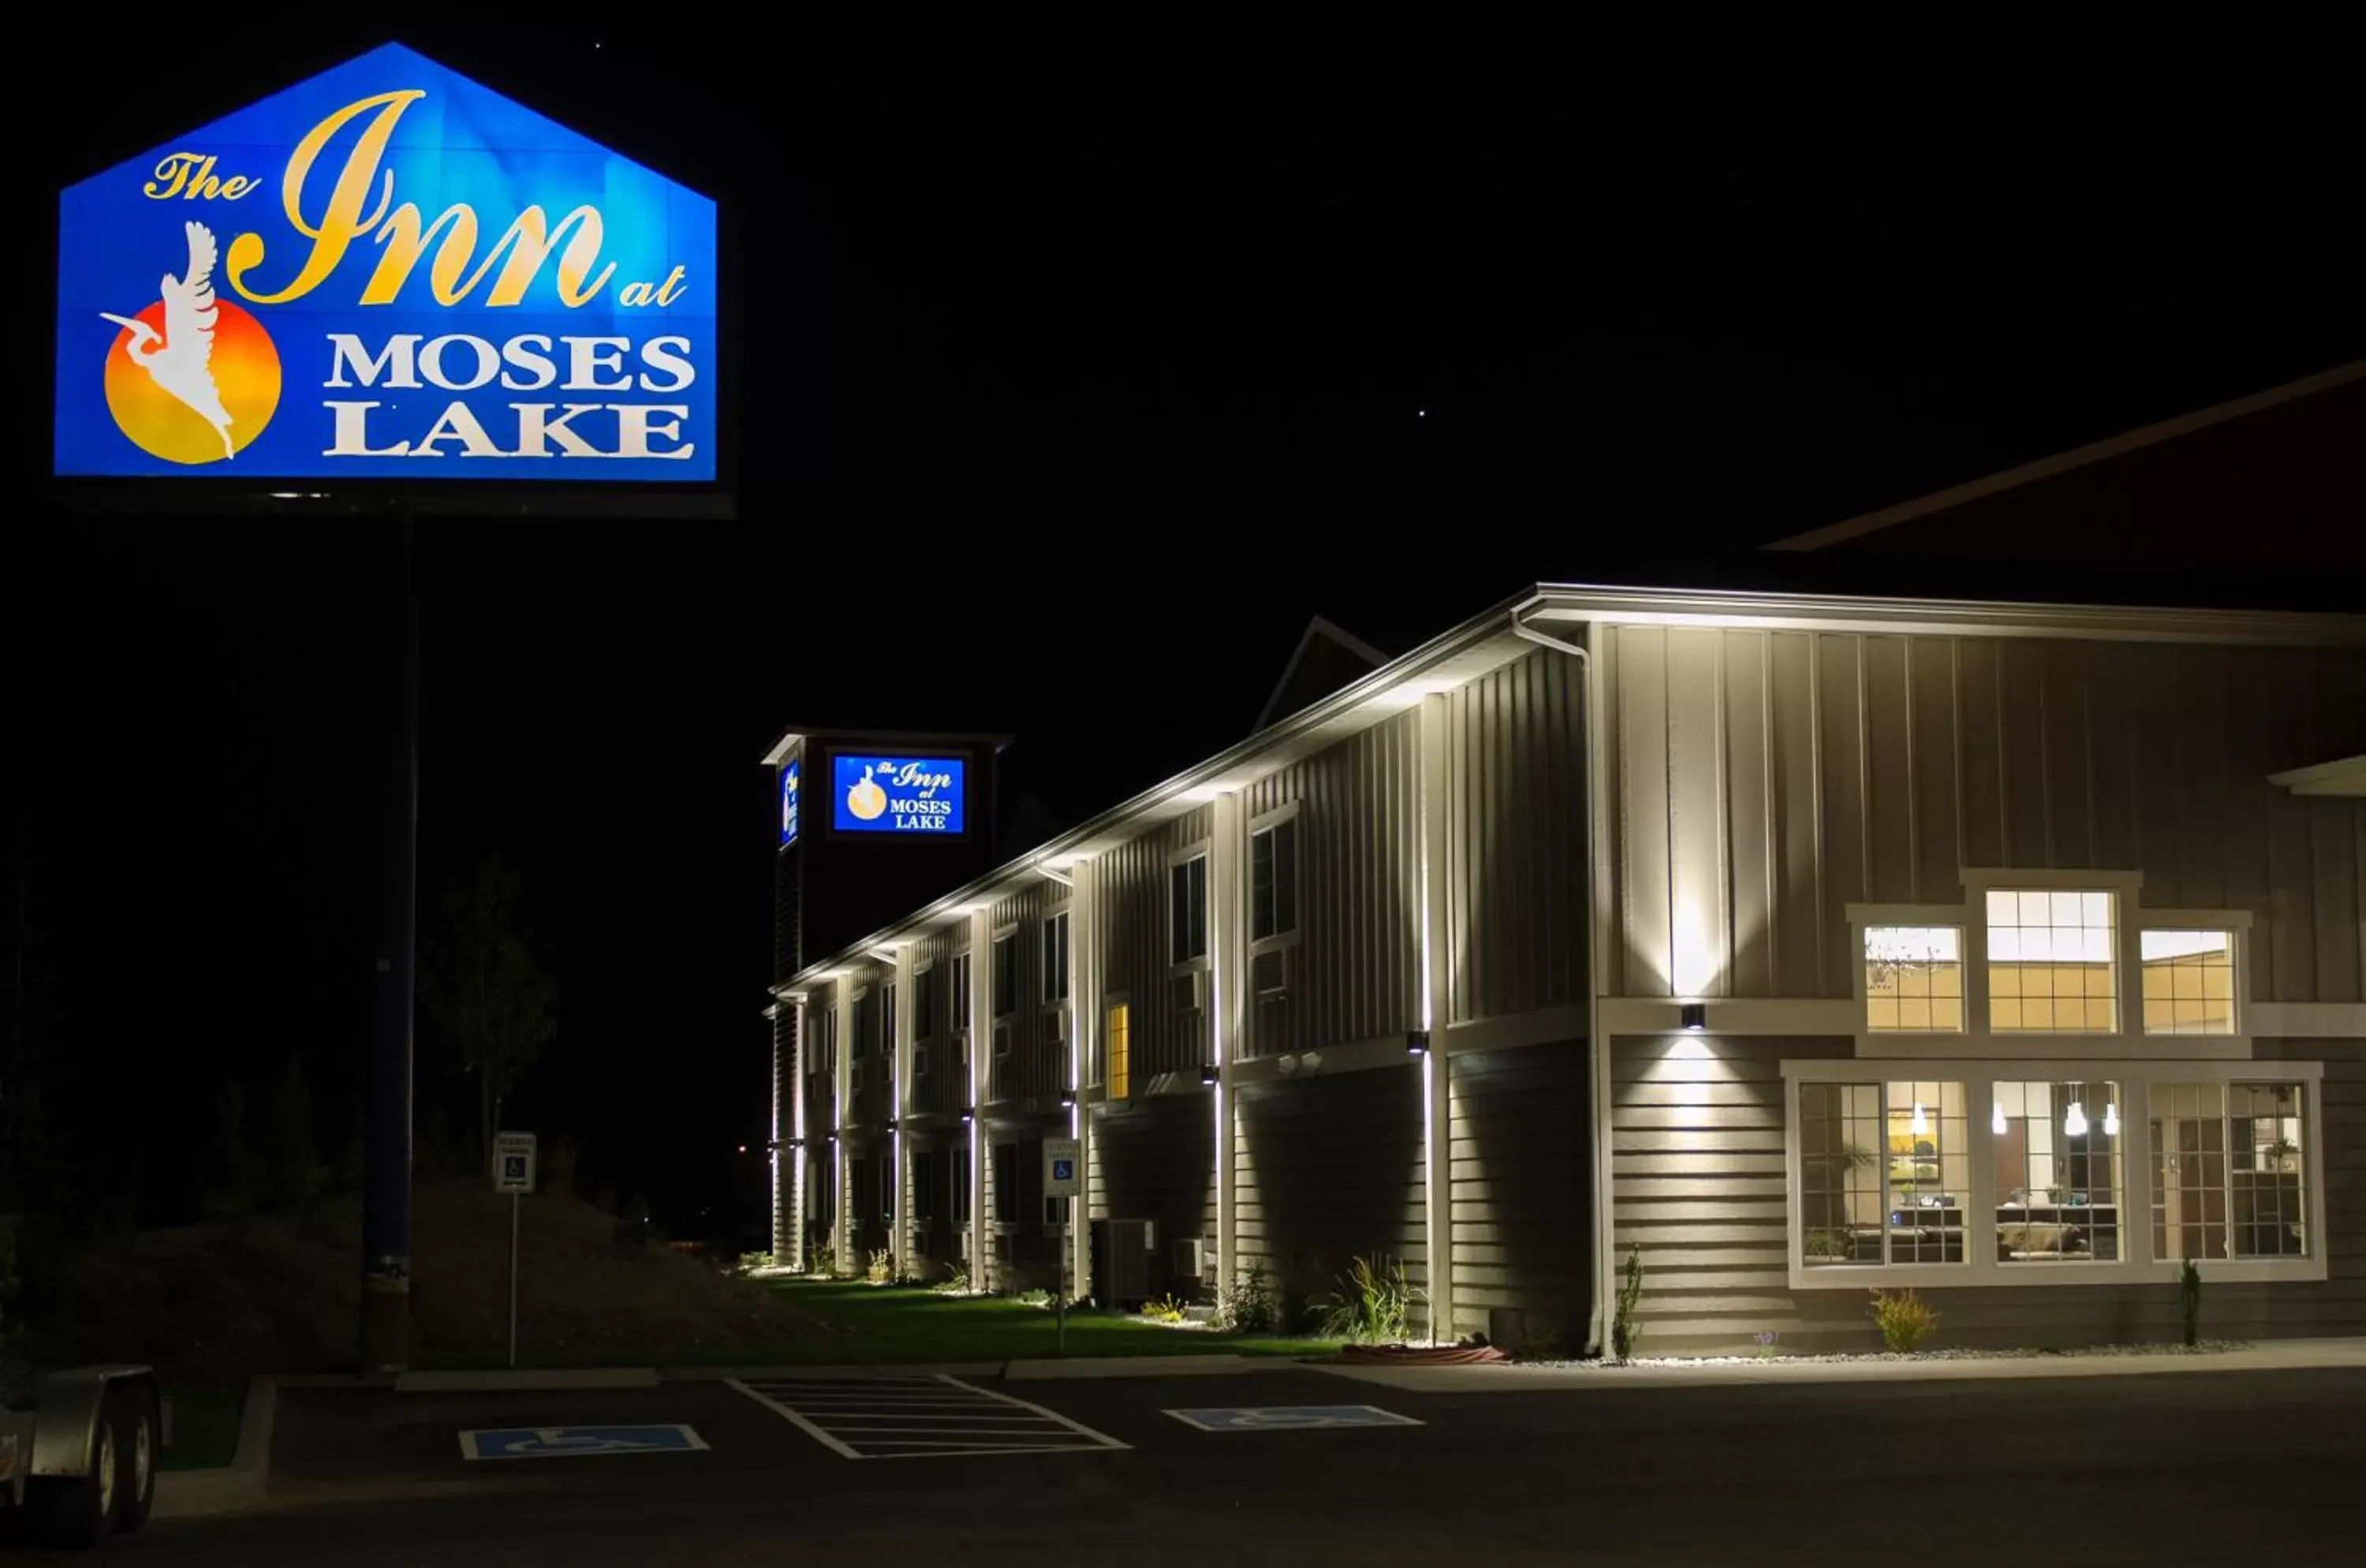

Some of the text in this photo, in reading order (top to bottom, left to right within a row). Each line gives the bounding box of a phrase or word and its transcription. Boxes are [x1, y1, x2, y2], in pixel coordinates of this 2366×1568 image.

[144, 89, 688, 308] The Inn at
[323, 333, 696, 392] MOSES
[322, 401, 694, 458] LAKE
[892, 762, 952, 787] Inn
[890, 799, 951, 815] MOSES
[895, 815, 946, 829] LAKE
